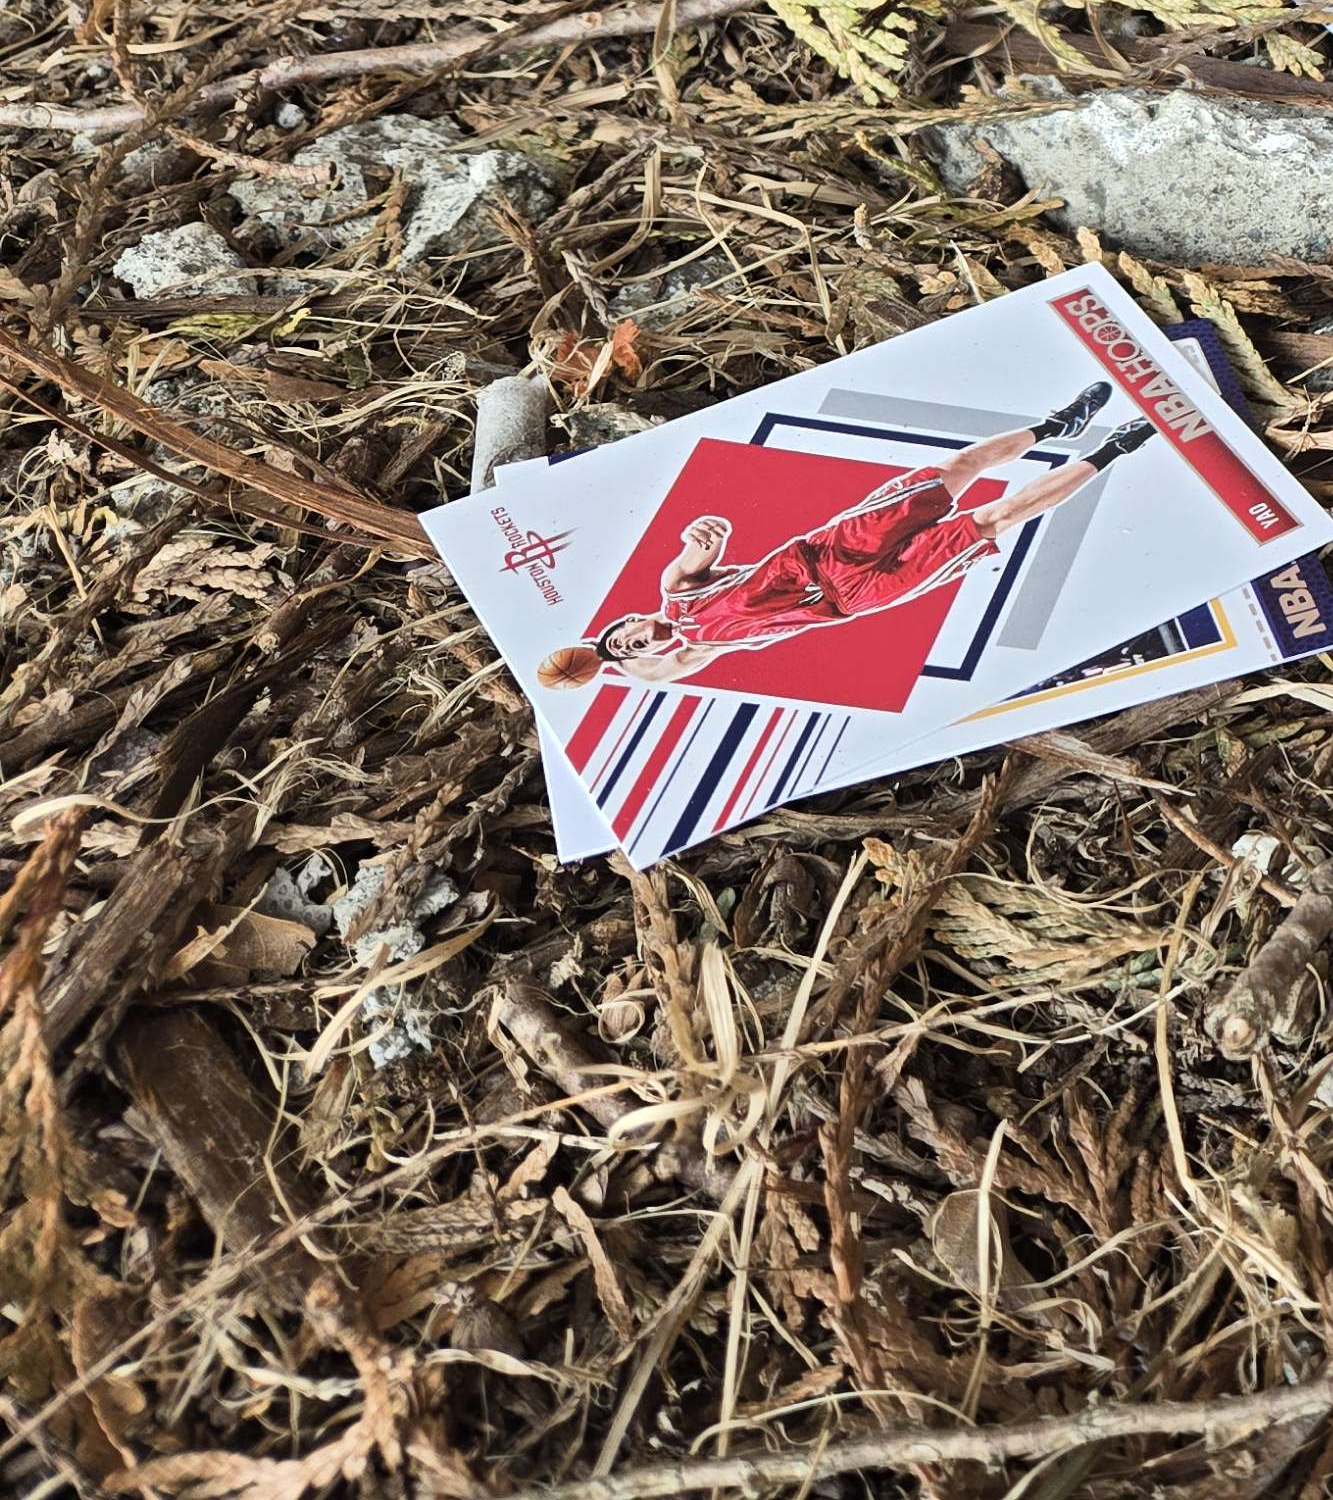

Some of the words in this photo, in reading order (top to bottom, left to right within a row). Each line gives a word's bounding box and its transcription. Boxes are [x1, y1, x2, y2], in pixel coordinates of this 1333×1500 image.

[1064, 294, 1156, 384] HOOPS
[1142, 375, 1217, 443] NBA
[489, 504, 527, 550] ROCKETS
[1248, 502, 1281, 530] YAO
[525, 560, 563, 606] HOUSTON
[1270, 563, 1328, 640] NBA
